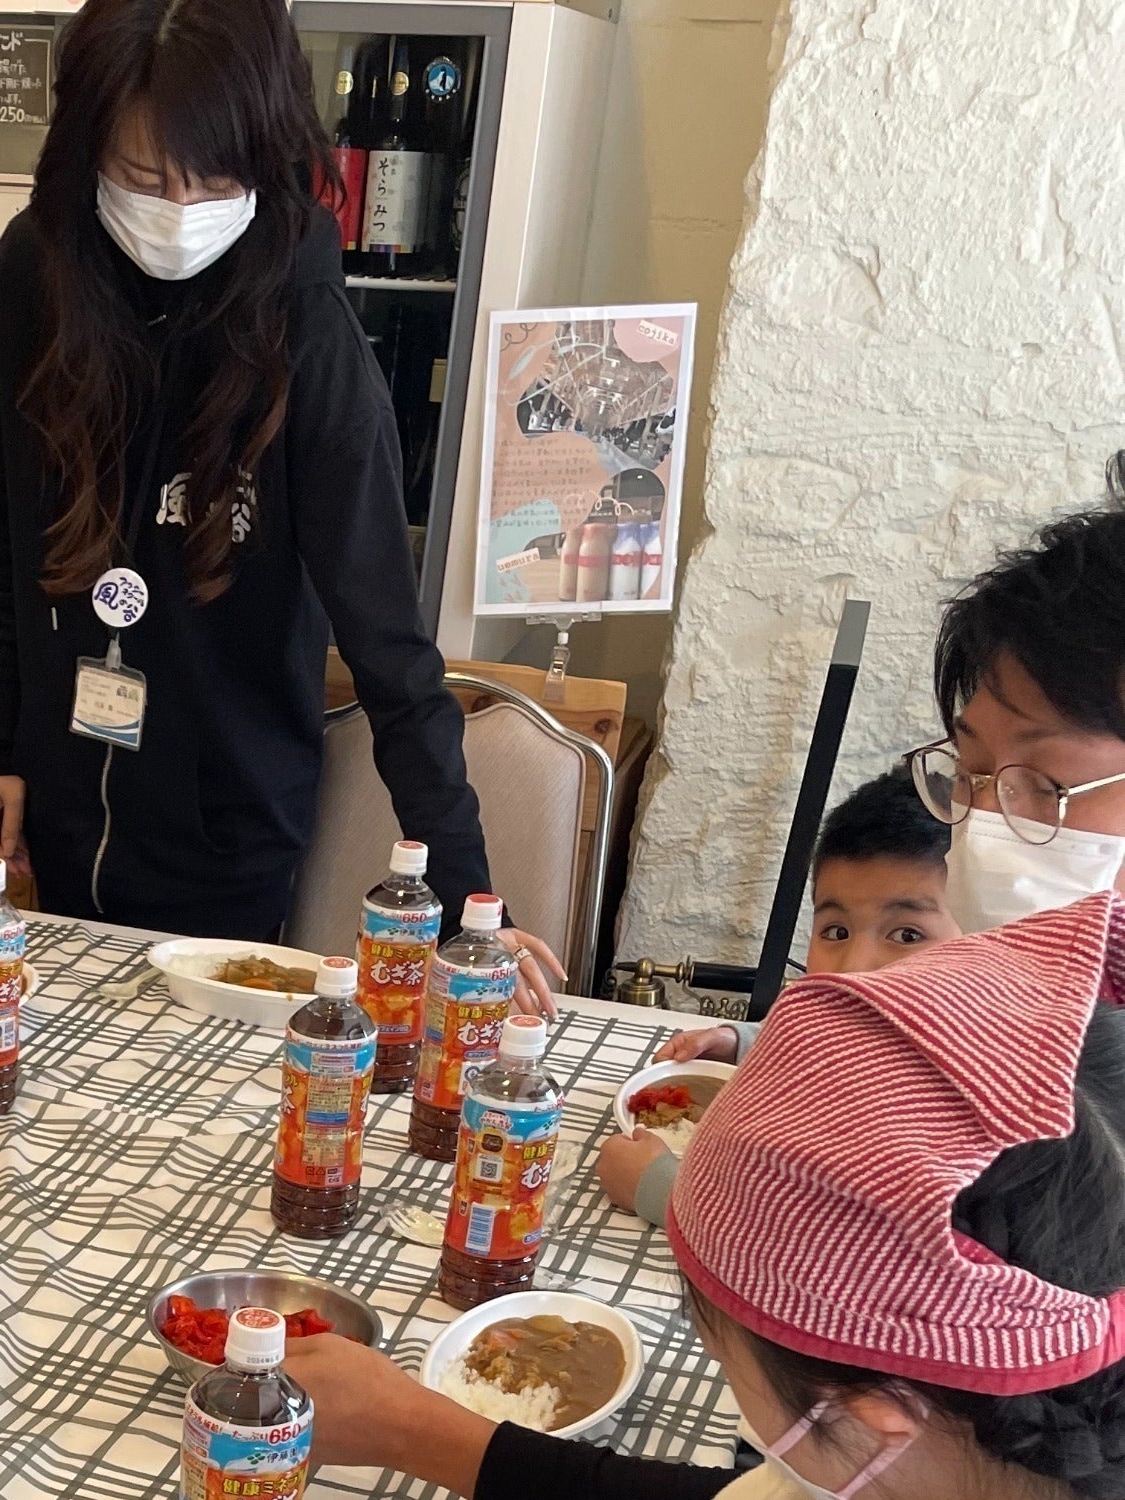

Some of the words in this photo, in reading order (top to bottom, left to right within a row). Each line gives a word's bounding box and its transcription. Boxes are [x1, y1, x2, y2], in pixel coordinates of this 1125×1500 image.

[372, 157, 390, 232] そらみつ
[370, 960, 425, 985] むぎ茶
[457, 1020, 505, 1046] むぎ茶
